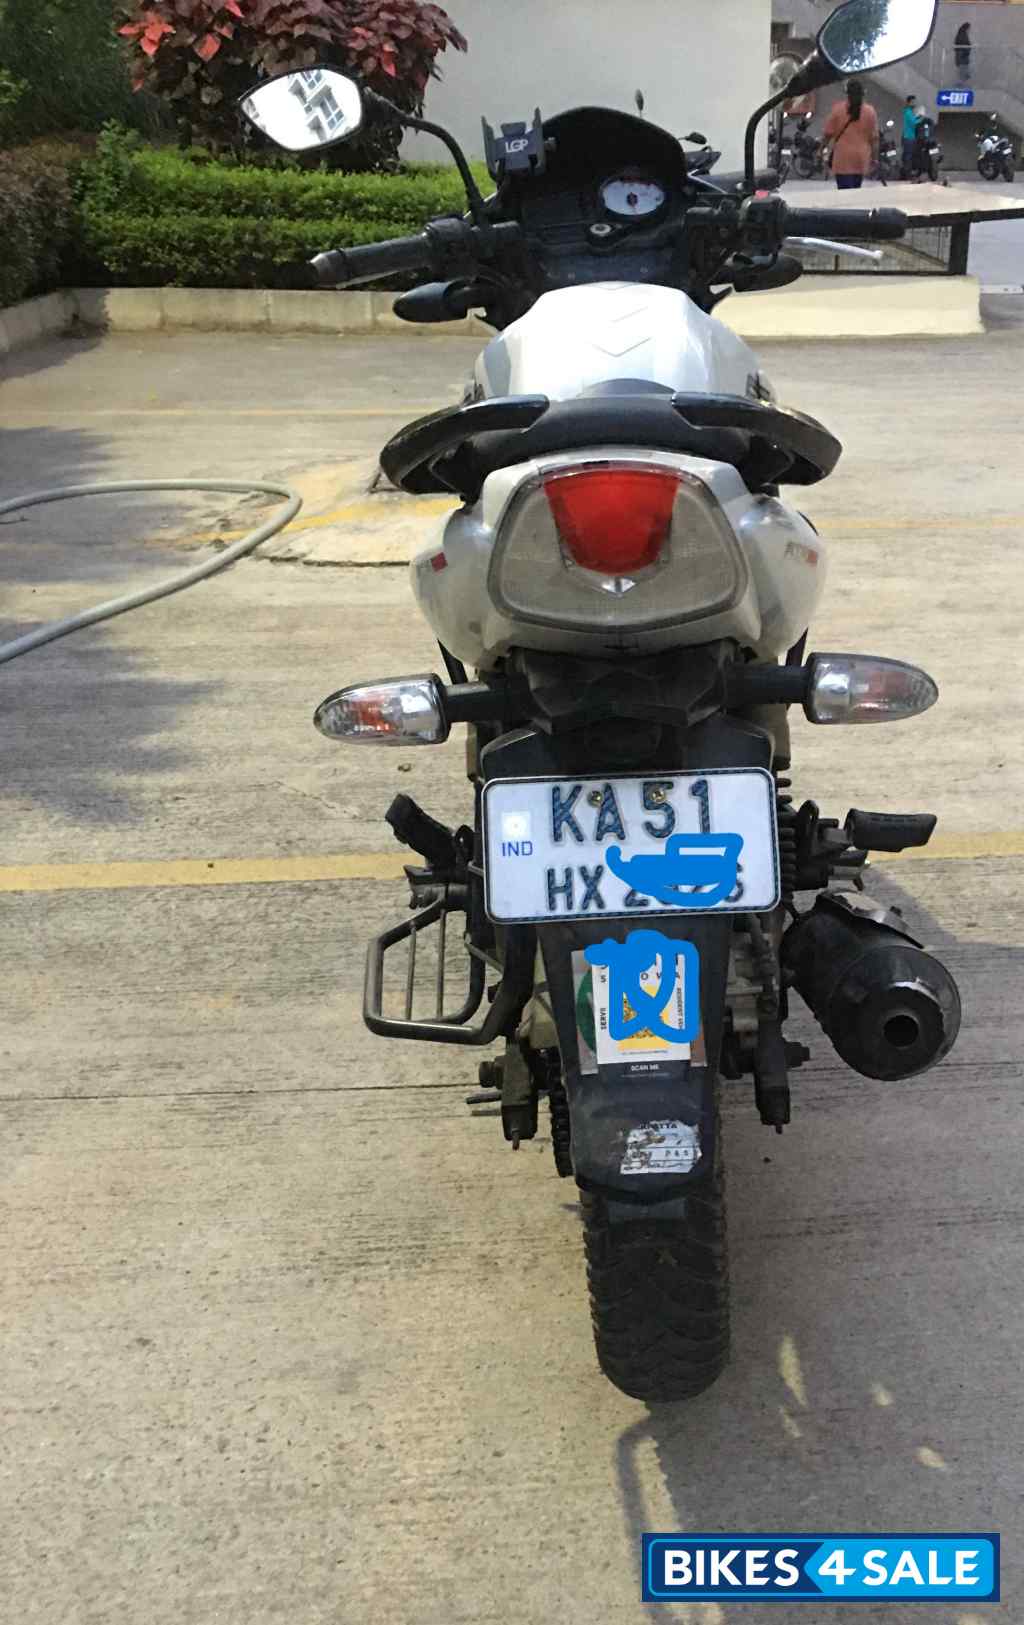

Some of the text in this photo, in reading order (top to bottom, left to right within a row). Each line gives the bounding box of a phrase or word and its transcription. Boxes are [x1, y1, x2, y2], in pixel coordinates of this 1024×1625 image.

[950, 92, 969, 104] EXIT
[505, 139, 529, 153] LGP
[501, 841, 533, 857] IND
[546, 865, 606, 911] HX
